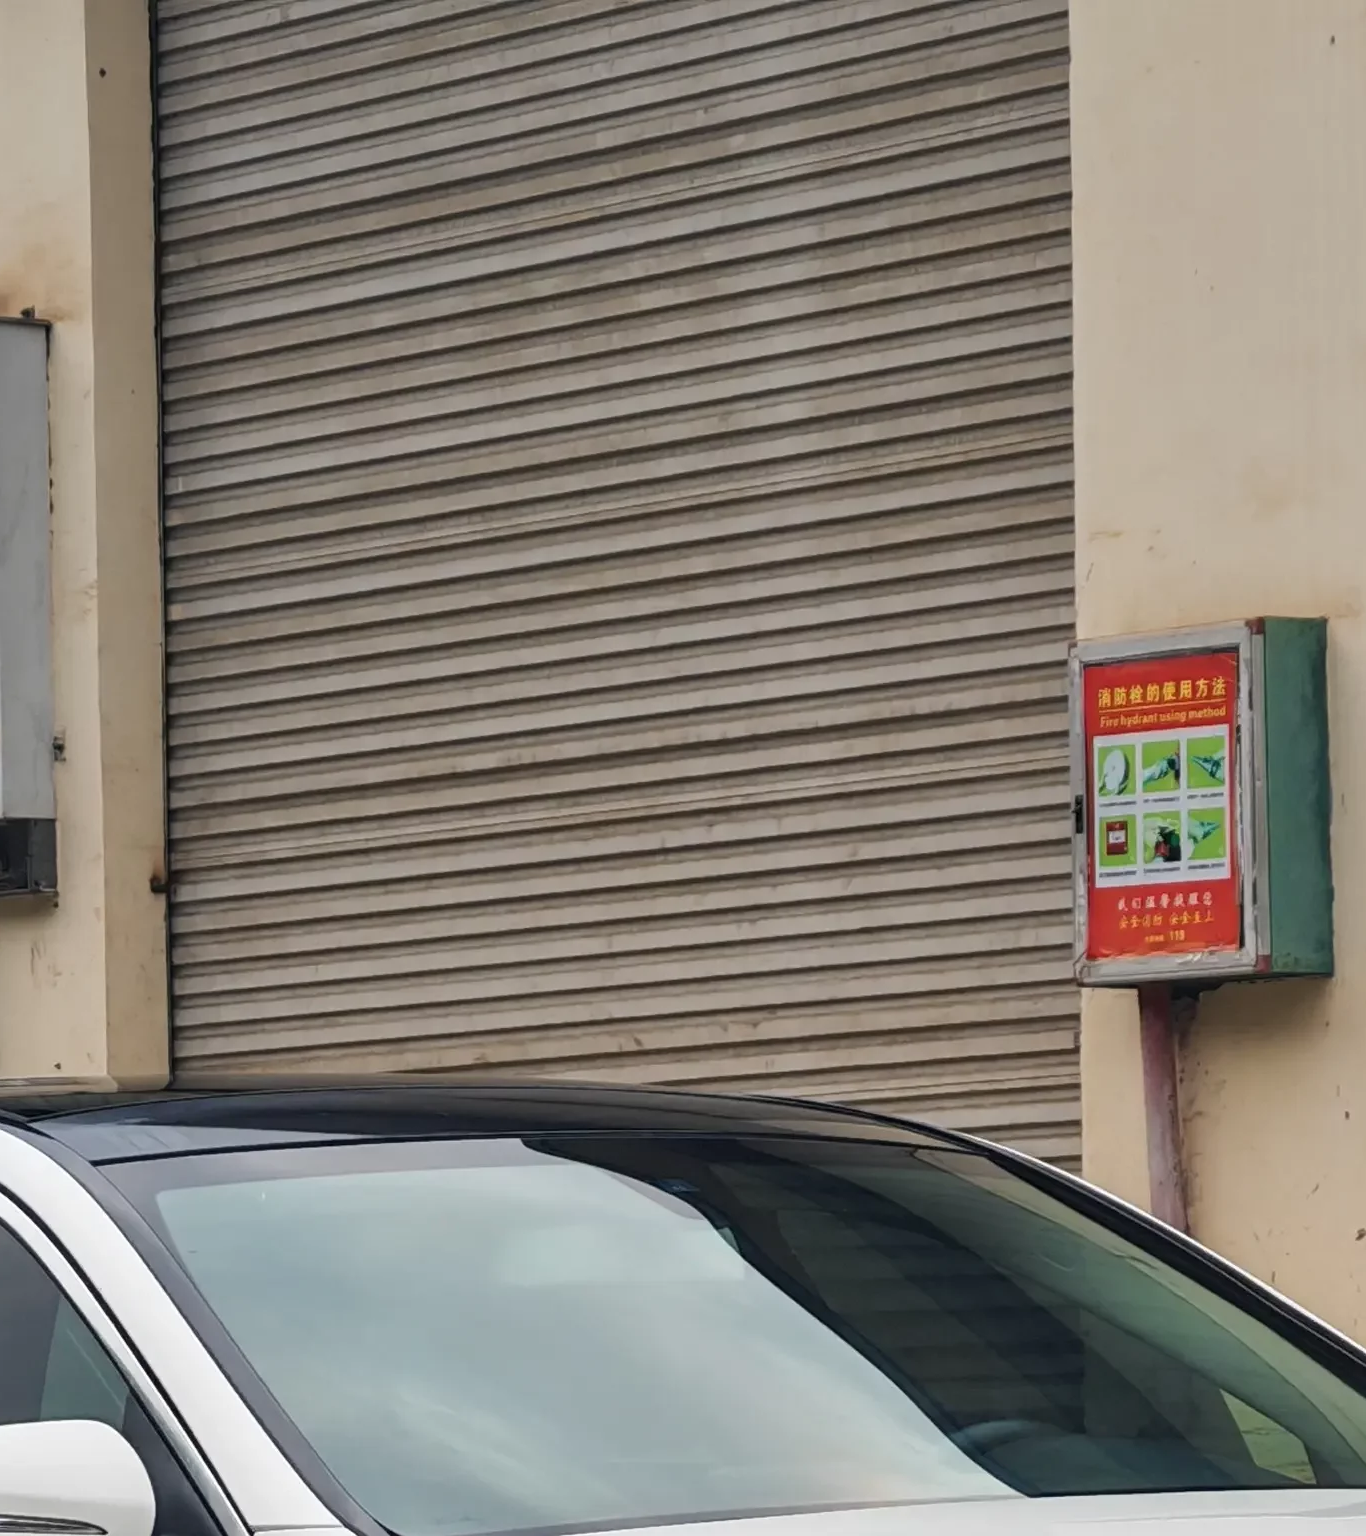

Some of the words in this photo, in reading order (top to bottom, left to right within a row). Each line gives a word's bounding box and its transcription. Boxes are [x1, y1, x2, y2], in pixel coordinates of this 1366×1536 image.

[1098, 676, 1227, 708] 消防栓的使用方法
[1100, 715, 1119, 729] Fire
[1120, 712, 1158, 727] hydrant
[1159, 710, 1187, 723] using
[1188, 706, 1227, 719] method
[1169, 929, 1186, 941] 119
